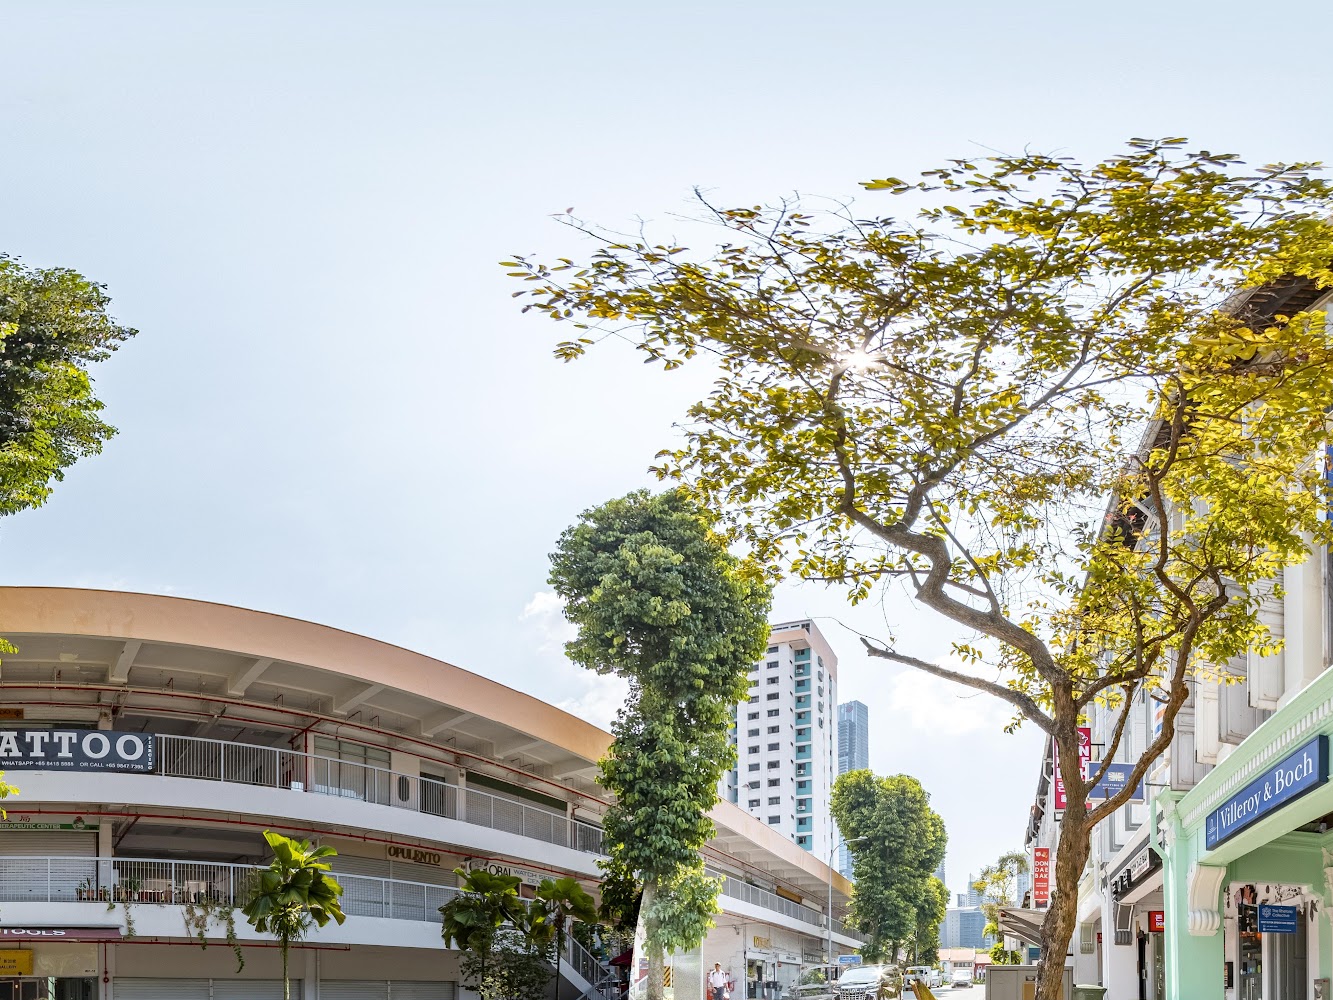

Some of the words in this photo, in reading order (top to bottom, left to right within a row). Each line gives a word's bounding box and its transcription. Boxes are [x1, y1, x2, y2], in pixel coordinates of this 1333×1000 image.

[1220, 790, 1262, 830] Villeroy
[1263, 781, 1273, 802] &
[1274, 751, 1314, 795] Boch
[388, 845, 441, 864] OPULENTO
[513, 869, 538, 879] WATCH
